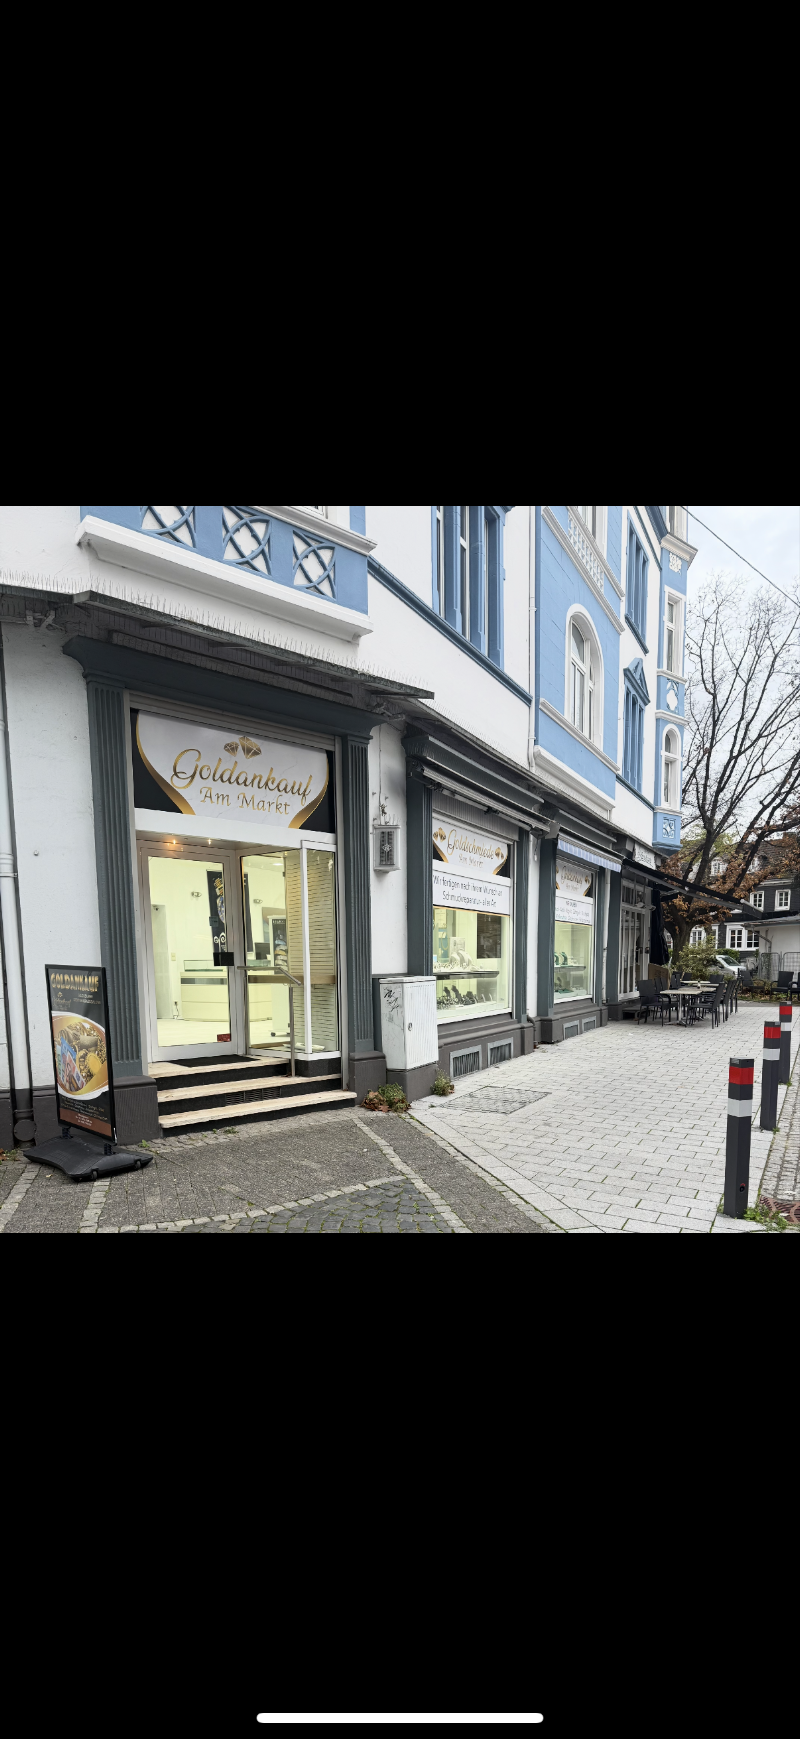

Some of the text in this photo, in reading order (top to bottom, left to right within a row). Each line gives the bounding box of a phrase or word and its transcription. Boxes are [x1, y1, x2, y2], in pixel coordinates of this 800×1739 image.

[170, 748, 313, 806] Goldankauf
[200, 786, 291, 815] Am Markt
[447, 829, 495, 859] Goldschmiede
[51, 972, 99, 992] GOLDANKAUF
